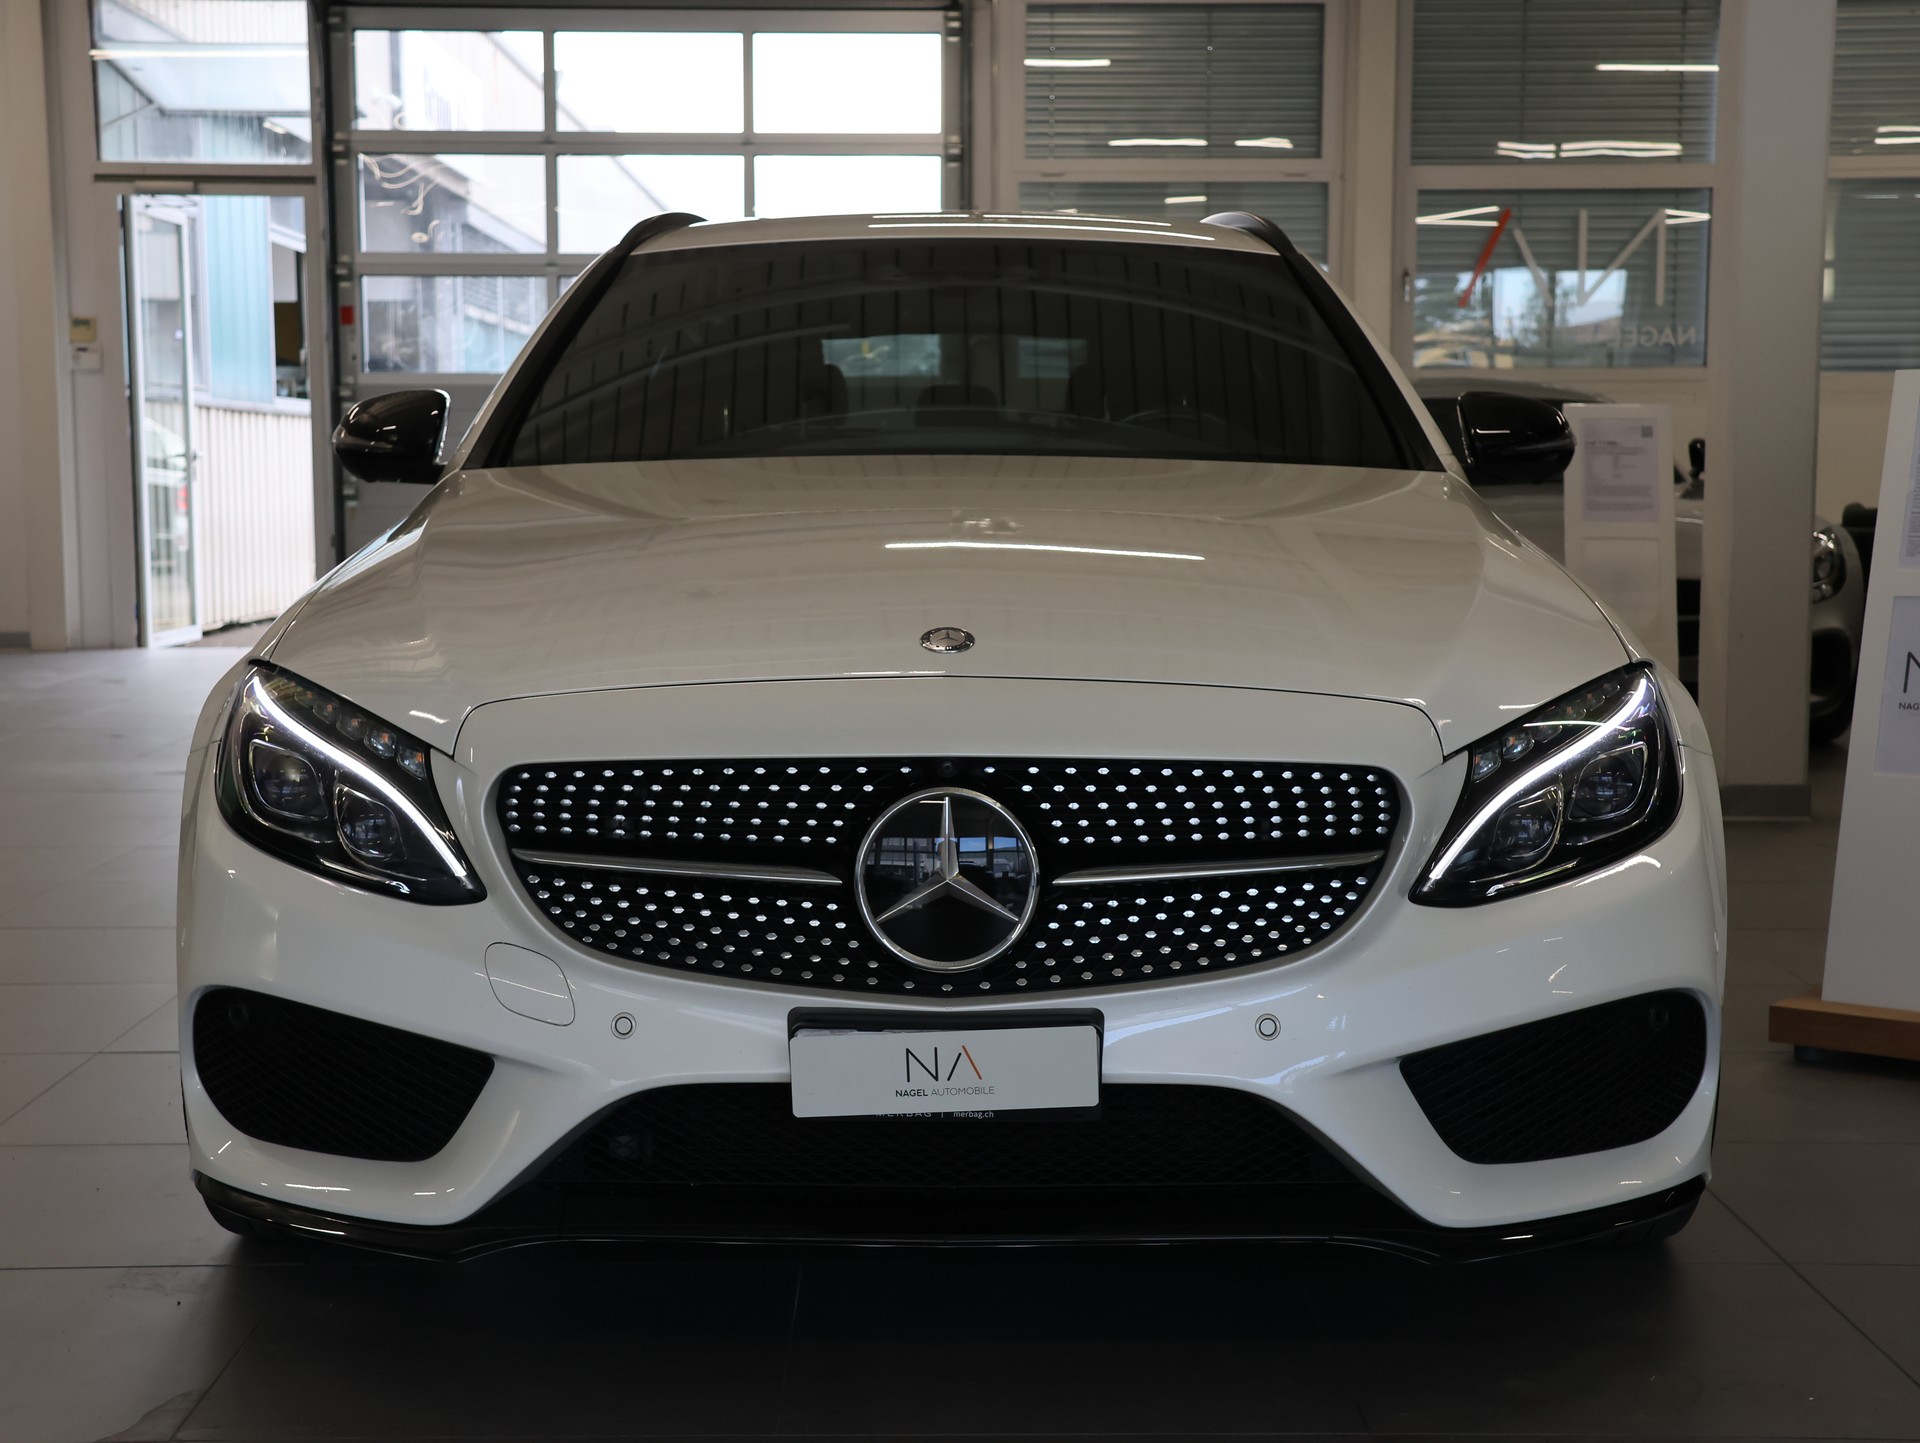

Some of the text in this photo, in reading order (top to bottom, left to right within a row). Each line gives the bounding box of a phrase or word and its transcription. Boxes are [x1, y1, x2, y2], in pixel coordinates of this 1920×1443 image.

[895, 1085, 995, 1098] NAGEL AUTOMOBILE
[953, 1110, 994, 1119] merbag.ch
